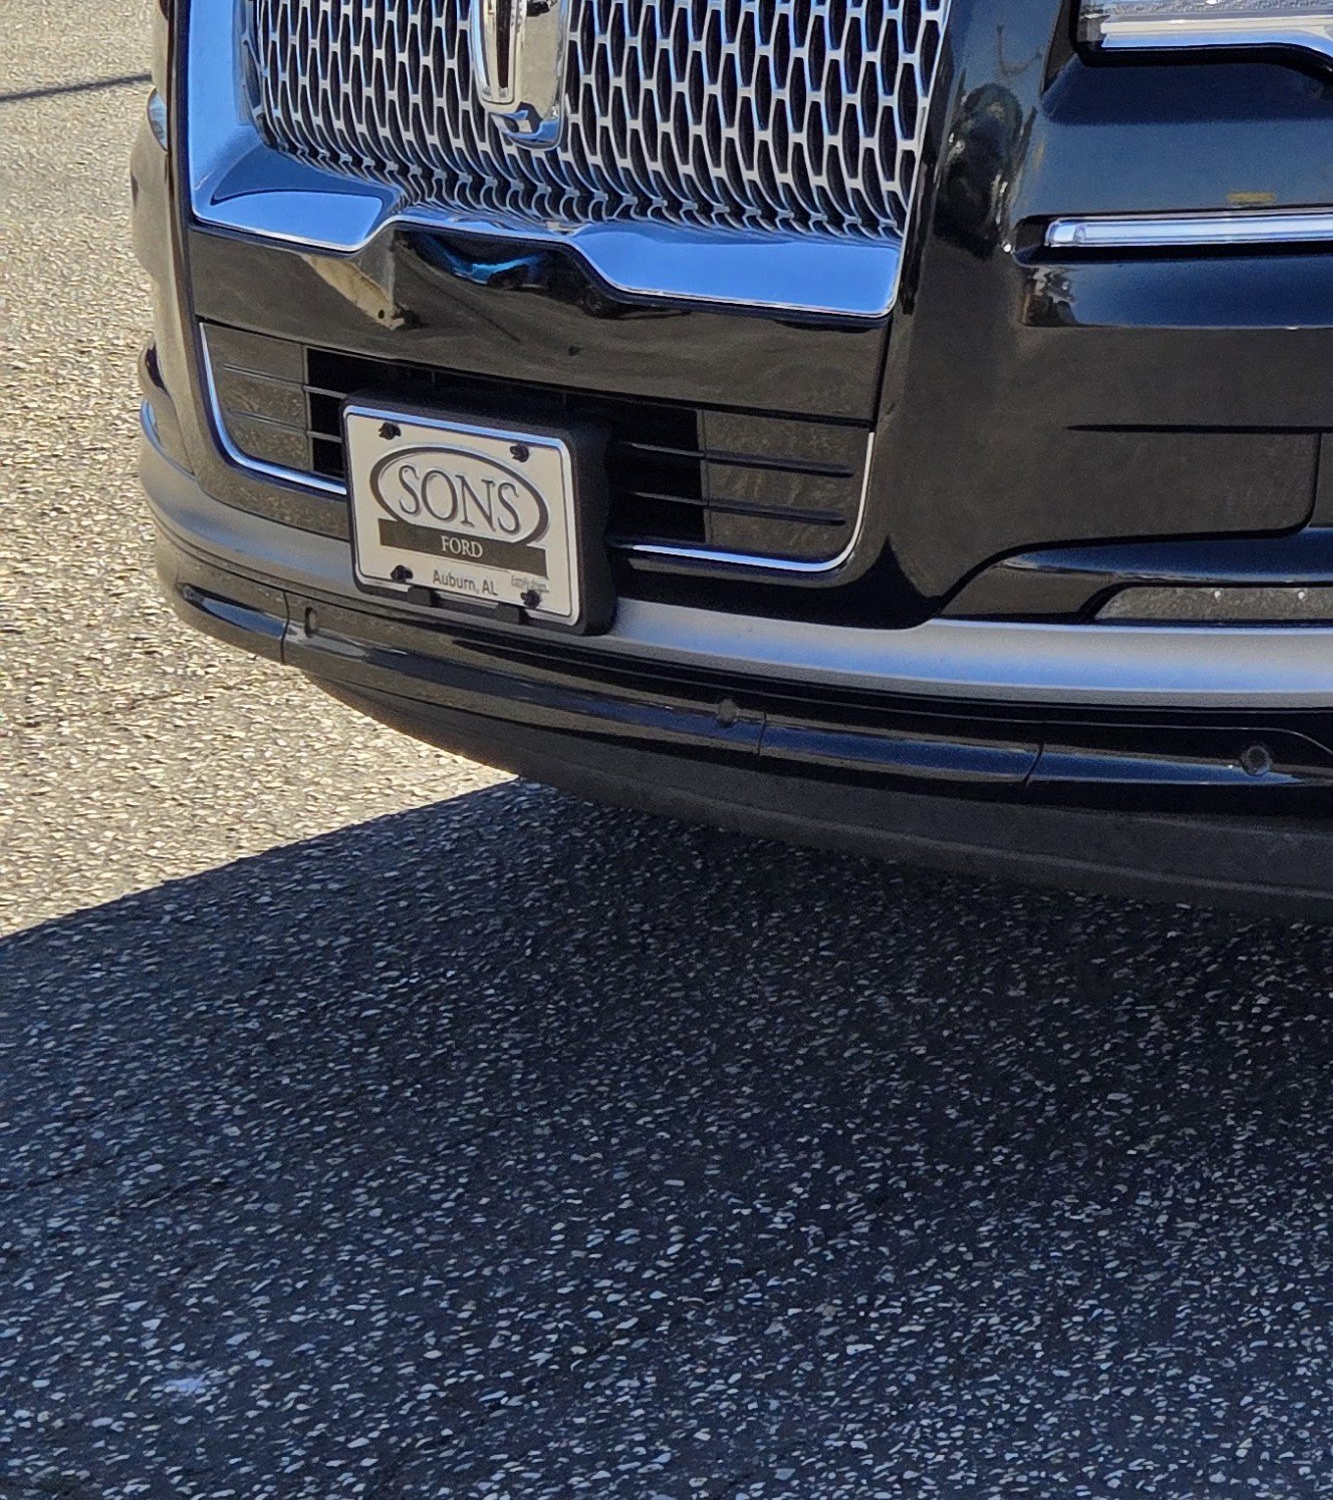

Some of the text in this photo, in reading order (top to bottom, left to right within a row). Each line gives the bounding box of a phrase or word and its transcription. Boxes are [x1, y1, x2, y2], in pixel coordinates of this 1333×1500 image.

[398, 464, 521, 534] SONS
[440, 535, 484, 559] FORD
[432, 569, 480, 594] Auburn,
[482, 579, 499, 597] AL
